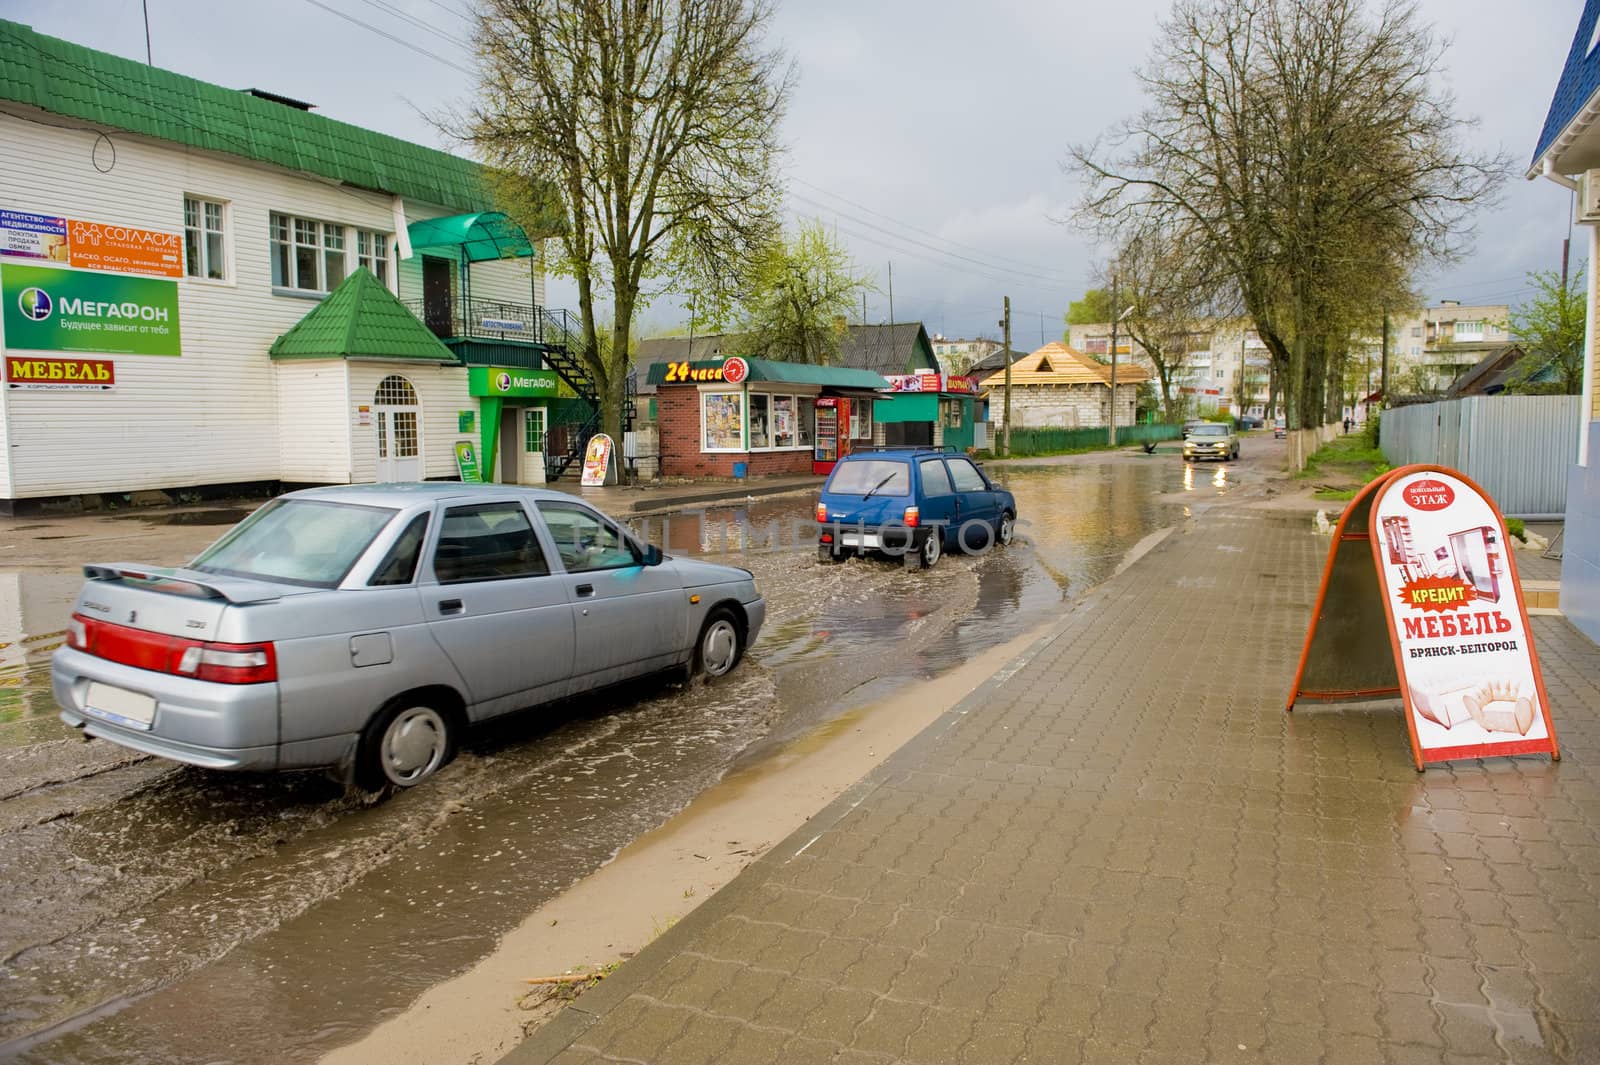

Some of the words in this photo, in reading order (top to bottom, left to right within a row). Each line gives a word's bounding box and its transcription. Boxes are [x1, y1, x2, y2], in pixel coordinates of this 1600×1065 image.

[1, 211, 44, 223] АГЕНТСТВО
[1, 219, 65, 233] НЕДВИЖИМОСТИ
[8, 230, 38, 238] ПОКУПКА
[8, 236, 40, 245] ПРОДАЖА
[104, 226, 178, 248] СОГЛАСИЕ
[61, 318, 102, 331] Будущее
[103, 323, 138, 333] зависит
[151, 324, 169, 335] тебя
[11, 361, 110, 380] МЕБЕЛЬ
[665, 361, 690, 381] 24
[690, 368, 723, 380] часа
[1411, 494, 1448, 506] ЭТАЖ
[1411, 586, 1465, 604] КРЕДИТ
[1402, 611, 1513, 640] МЕБЕЛЬ
[1409, 640, 1518, 658] БРЯНСК-БЕЛГОРОД
